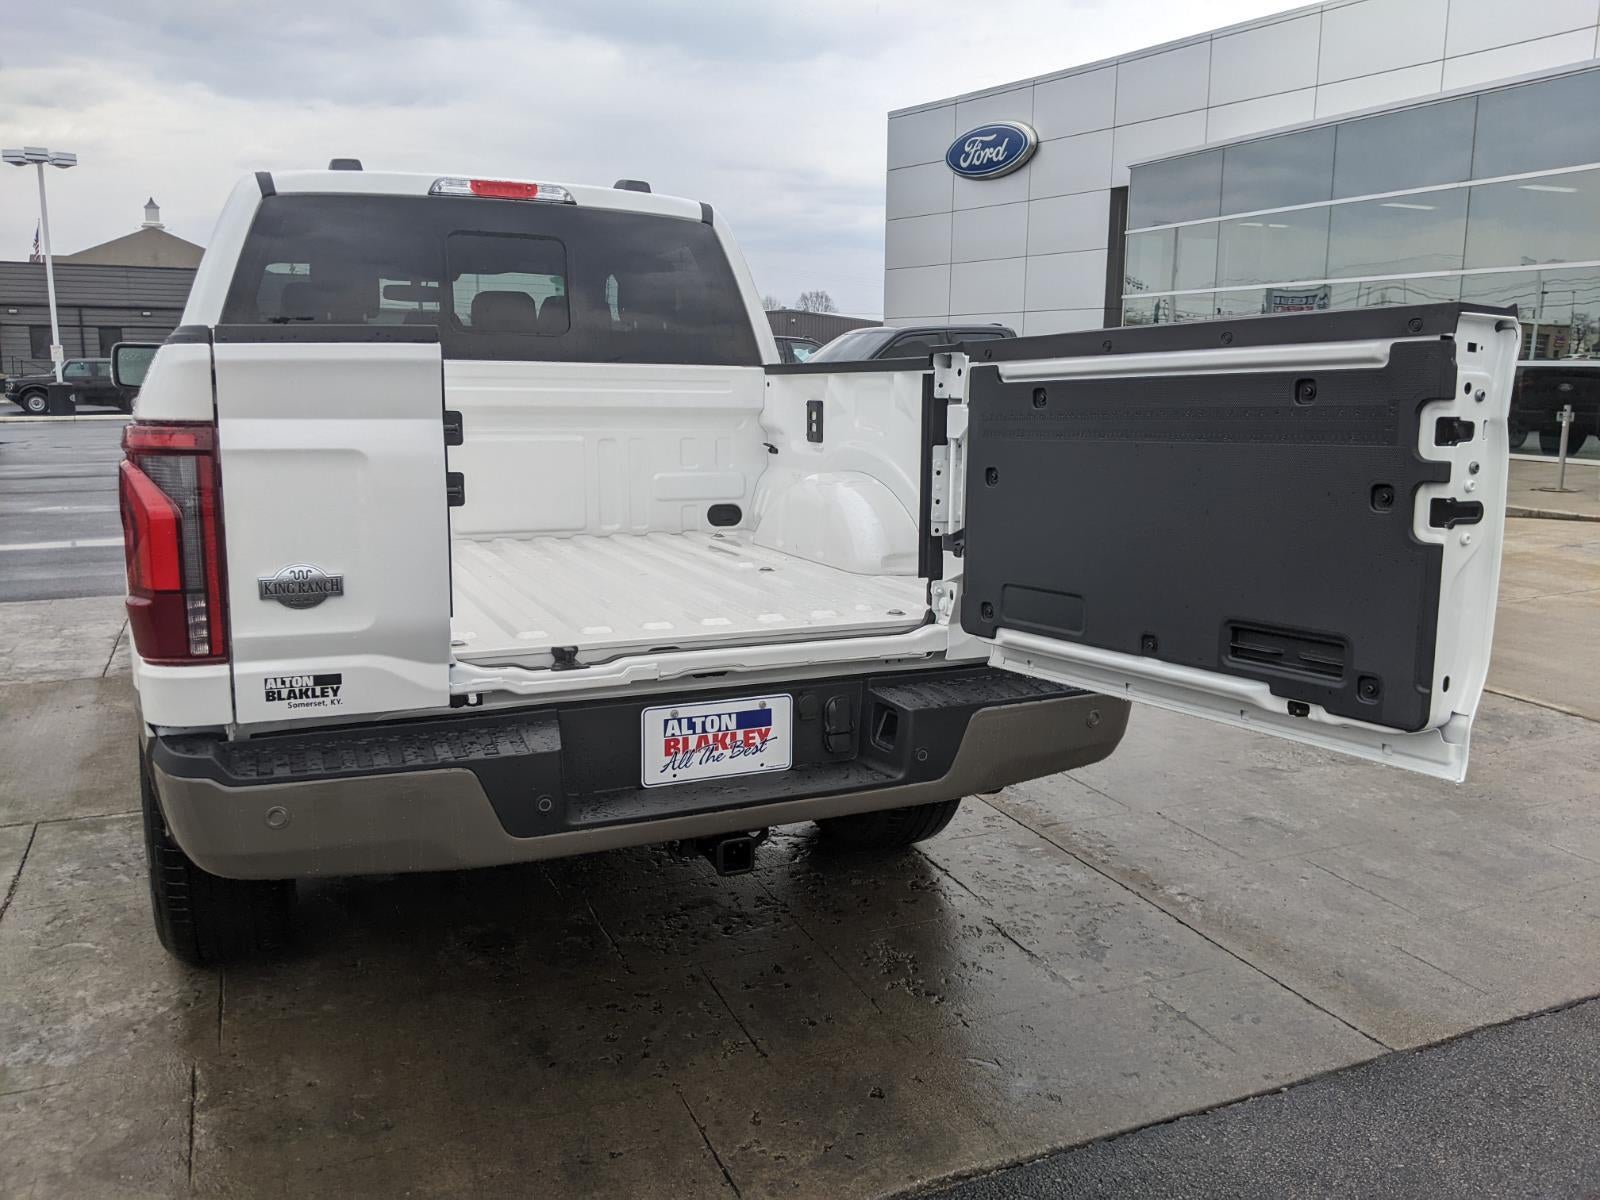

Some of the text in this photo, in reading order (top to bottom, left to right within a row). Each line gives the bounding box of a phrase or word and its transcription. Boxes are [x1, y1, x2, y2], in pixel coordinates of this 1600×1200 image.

[960, 133, 1009, 168] Ford
[264, 578, 340, 596] KING RANCH
[265, 675, 314, 689] ALTON
[264, 686, 341, 702] BLAKLEY
[287, 698, 343, 709] Somerset, KY.
[664, 713, 737, 737] ALTON
[664, 727, 772, 757] BLAKLEY
[660, 736, 778, 774] All The Best
